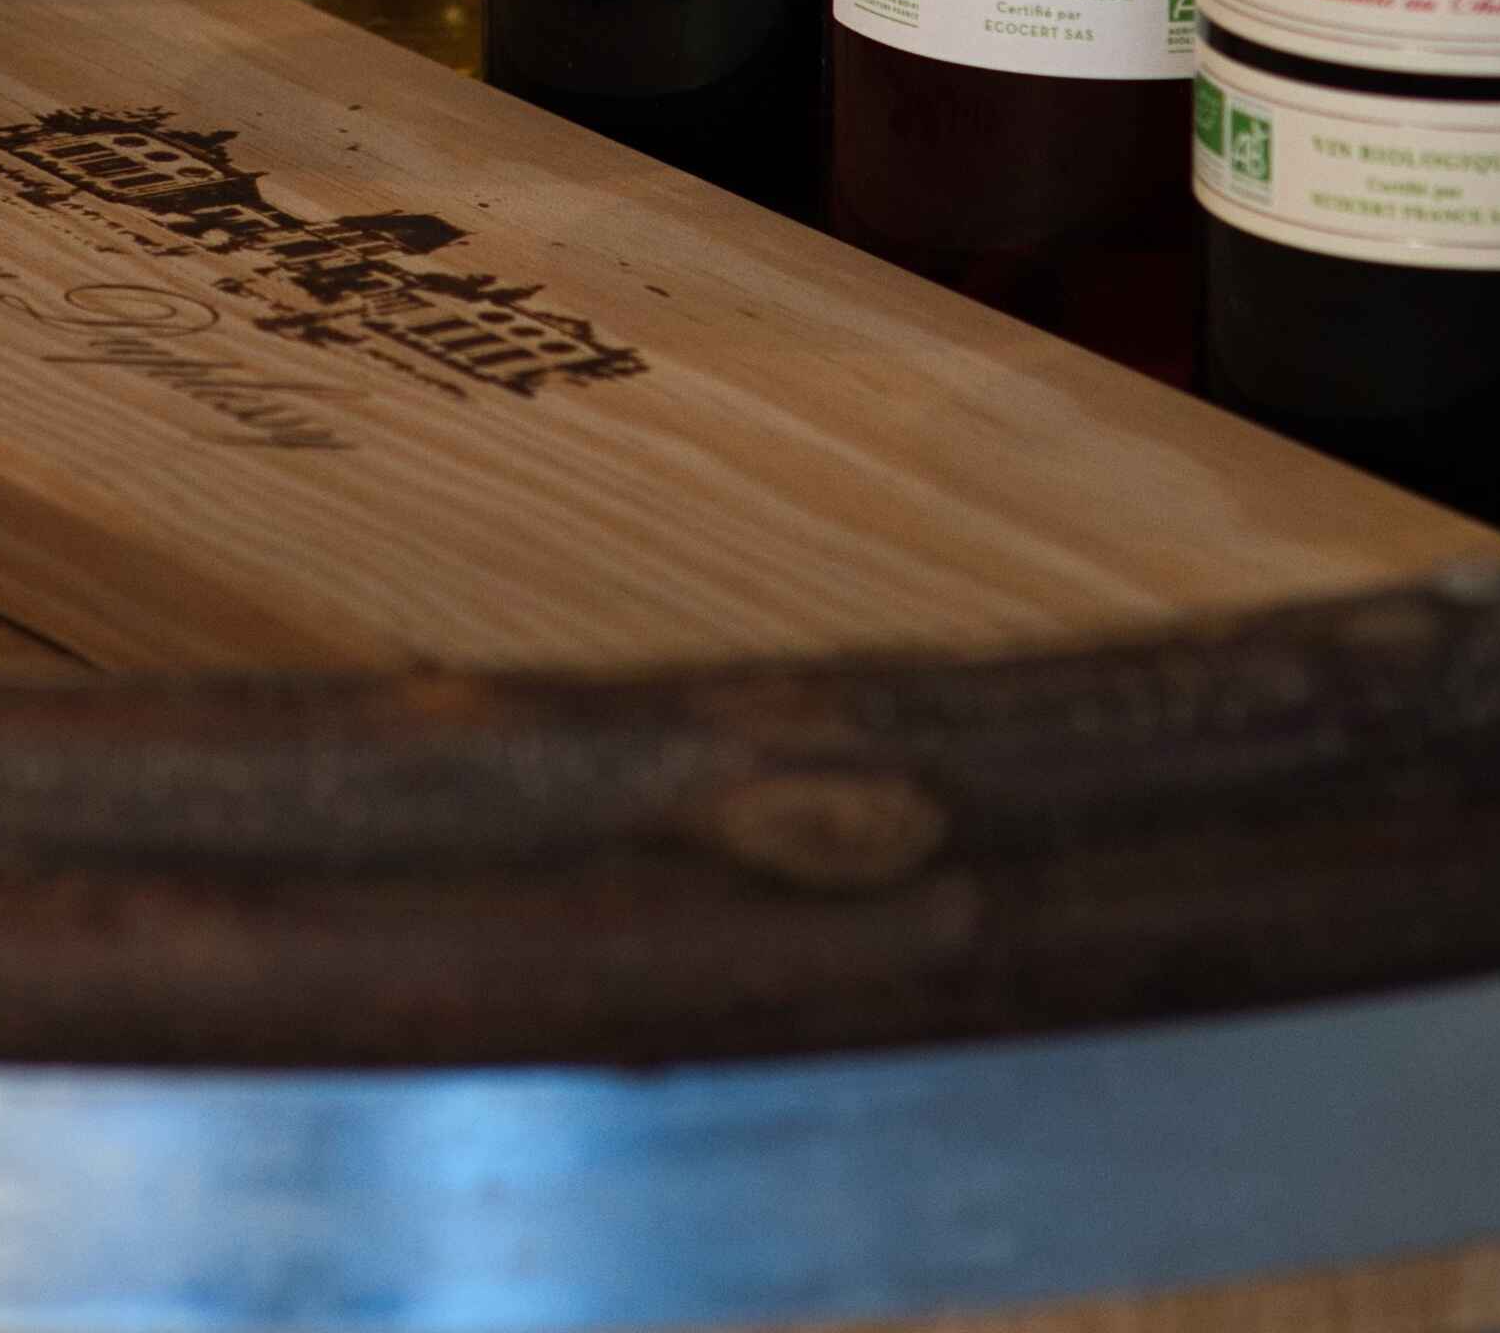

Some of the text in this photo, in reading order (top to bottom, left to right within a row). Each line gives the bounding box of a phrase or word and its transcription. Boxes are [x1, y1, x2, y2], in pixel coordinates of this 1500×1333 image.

[996, 0, 1082, 25] Certifié par
[984, 19, 1096, 43] ECOCERT SAS
